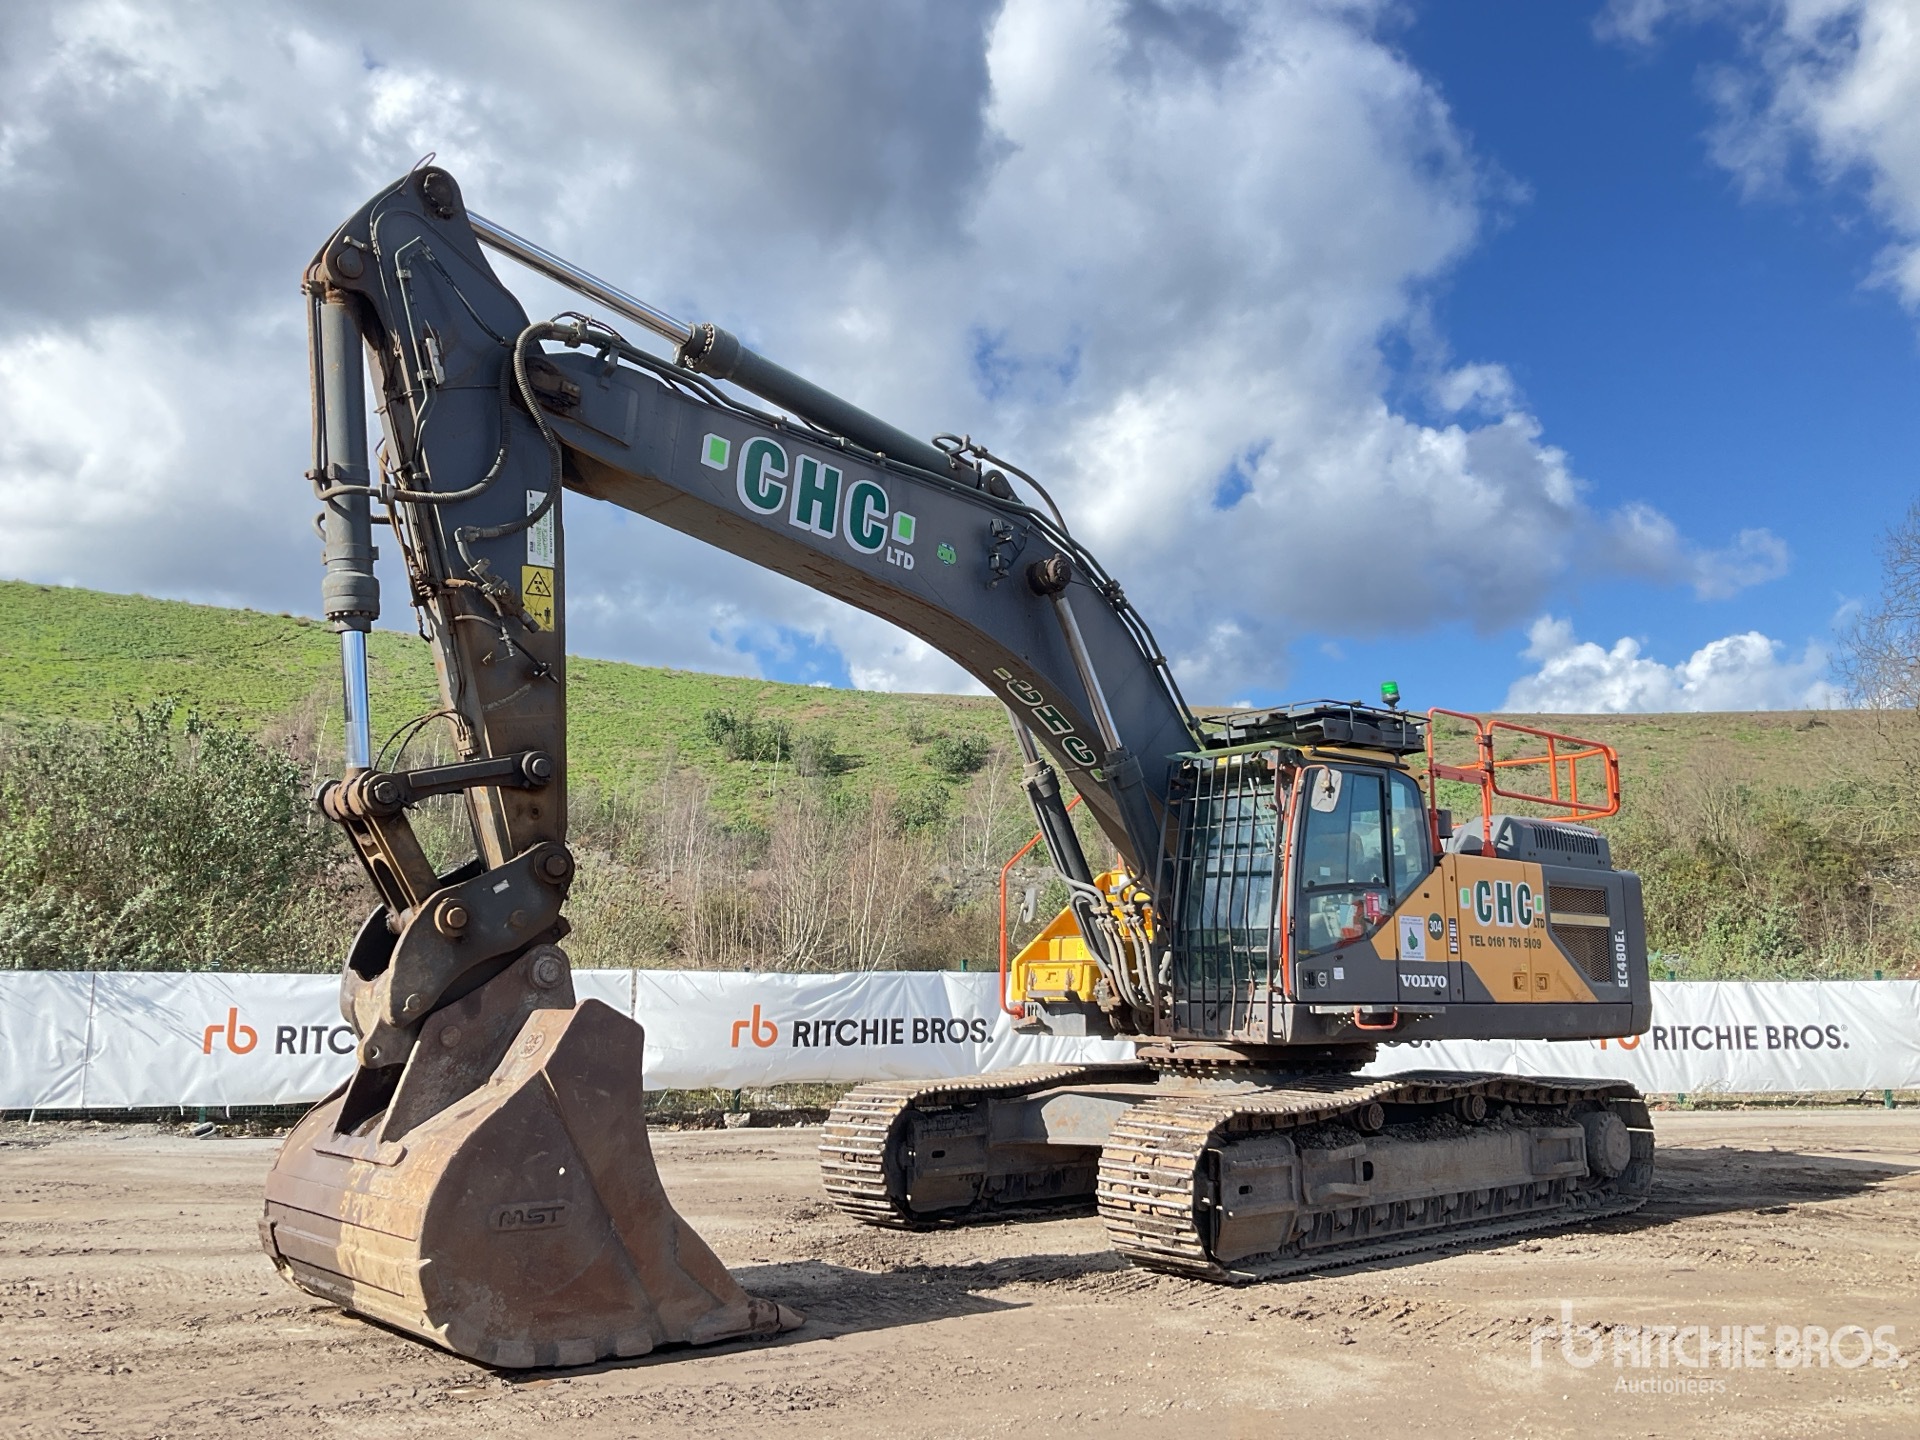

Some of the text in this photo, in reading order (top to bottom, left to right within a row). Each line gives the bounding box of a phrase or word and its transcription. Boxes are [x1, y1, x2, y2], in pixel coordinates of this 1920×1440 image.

[736, 437, 889, 554] CHC
[886, 546, 915, 571] LTD
[1006, 680, 1097, 767] CHC
[1474, 880, 1534, 928] CHC
[1429, 920, 1442, 932] 304
[1533, 917, 1545, 929] LTD
[1469, 935, 1486, 947] TEL
[1488, 935, 1505, 948] 0161
[1508, 936, 1521, 948] 761
[1400, 974, 1447, 988] VOLVO
[203, 1007, 356, 1055] rb RITC
[731, 1004, 994, 1048] rb RITCHIE BROS.
[1652, 1025, 1759, 1050] RITCHIE
[1765, 1024, 1850, 1050] BROS.
[499, 1205, 565, 1228] MST
